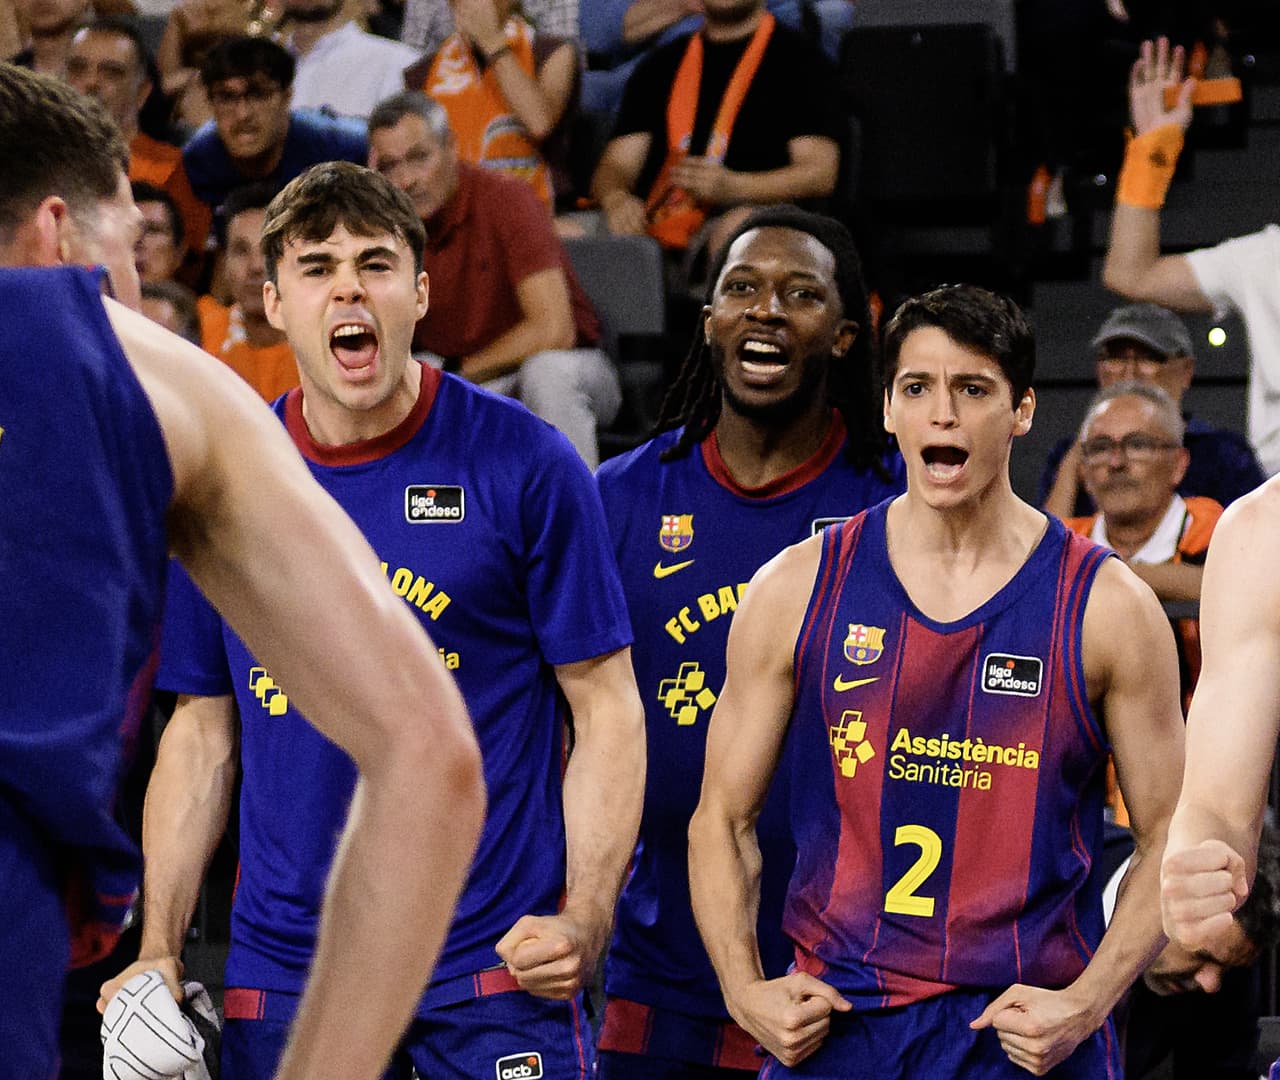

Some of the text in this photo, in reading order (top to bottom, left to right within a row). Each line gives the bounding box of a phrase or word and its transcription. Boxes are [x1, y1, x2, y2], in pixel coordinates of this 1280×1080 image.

[664, 606, 700, 644] FC
[988, 677, 1037, 691] endesa
[989, 664, 1012, 678] liga
[890, 728, 1040, 769] Assistència
[888, 754, 992, 790] Sanitària
[884, 824, 942, 917] 2
[501, 1064, 532, 1080] acb
